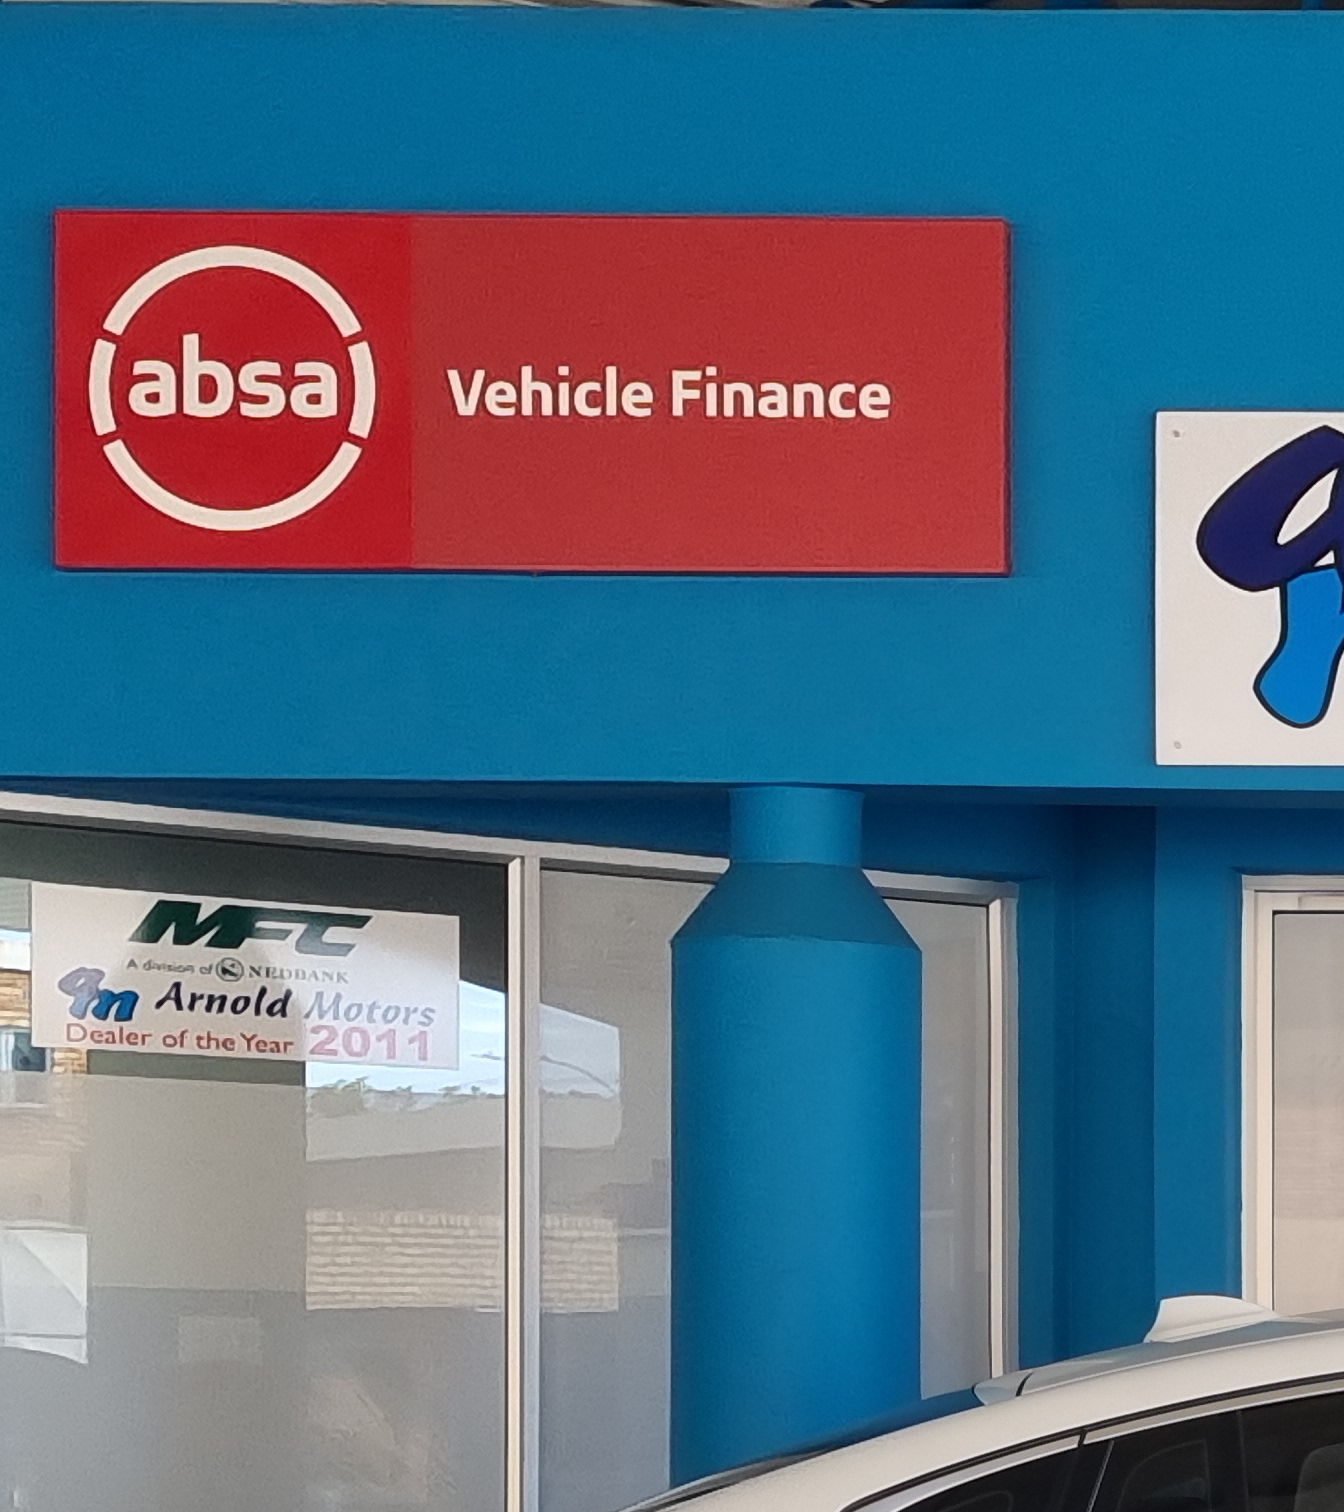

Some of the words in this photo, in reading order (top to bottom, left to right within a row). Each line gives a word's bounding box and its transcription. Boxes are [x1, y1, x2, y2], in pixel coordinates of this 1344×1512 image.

[129, 333, 338, 418] absa
[447, 365, 654, 418] Vehicle
[671, 366, 891, 419] Finance
[129, 899, 372, 957] MFC
[126, 959, 138, 970] A
[249, 964, 350, 985] NEDBANK
[155, 980, 294, 1019] Arnold
[304, 991, 437, 1027] Motors
[66, 1022, 152, 1047] Dealer
[162, 1029, 189, 1049] of
[196, 1031, 236, 1051] the
[240, 1032, 295, 1054] Year
[309, 1024, 430, 1062] 2011
